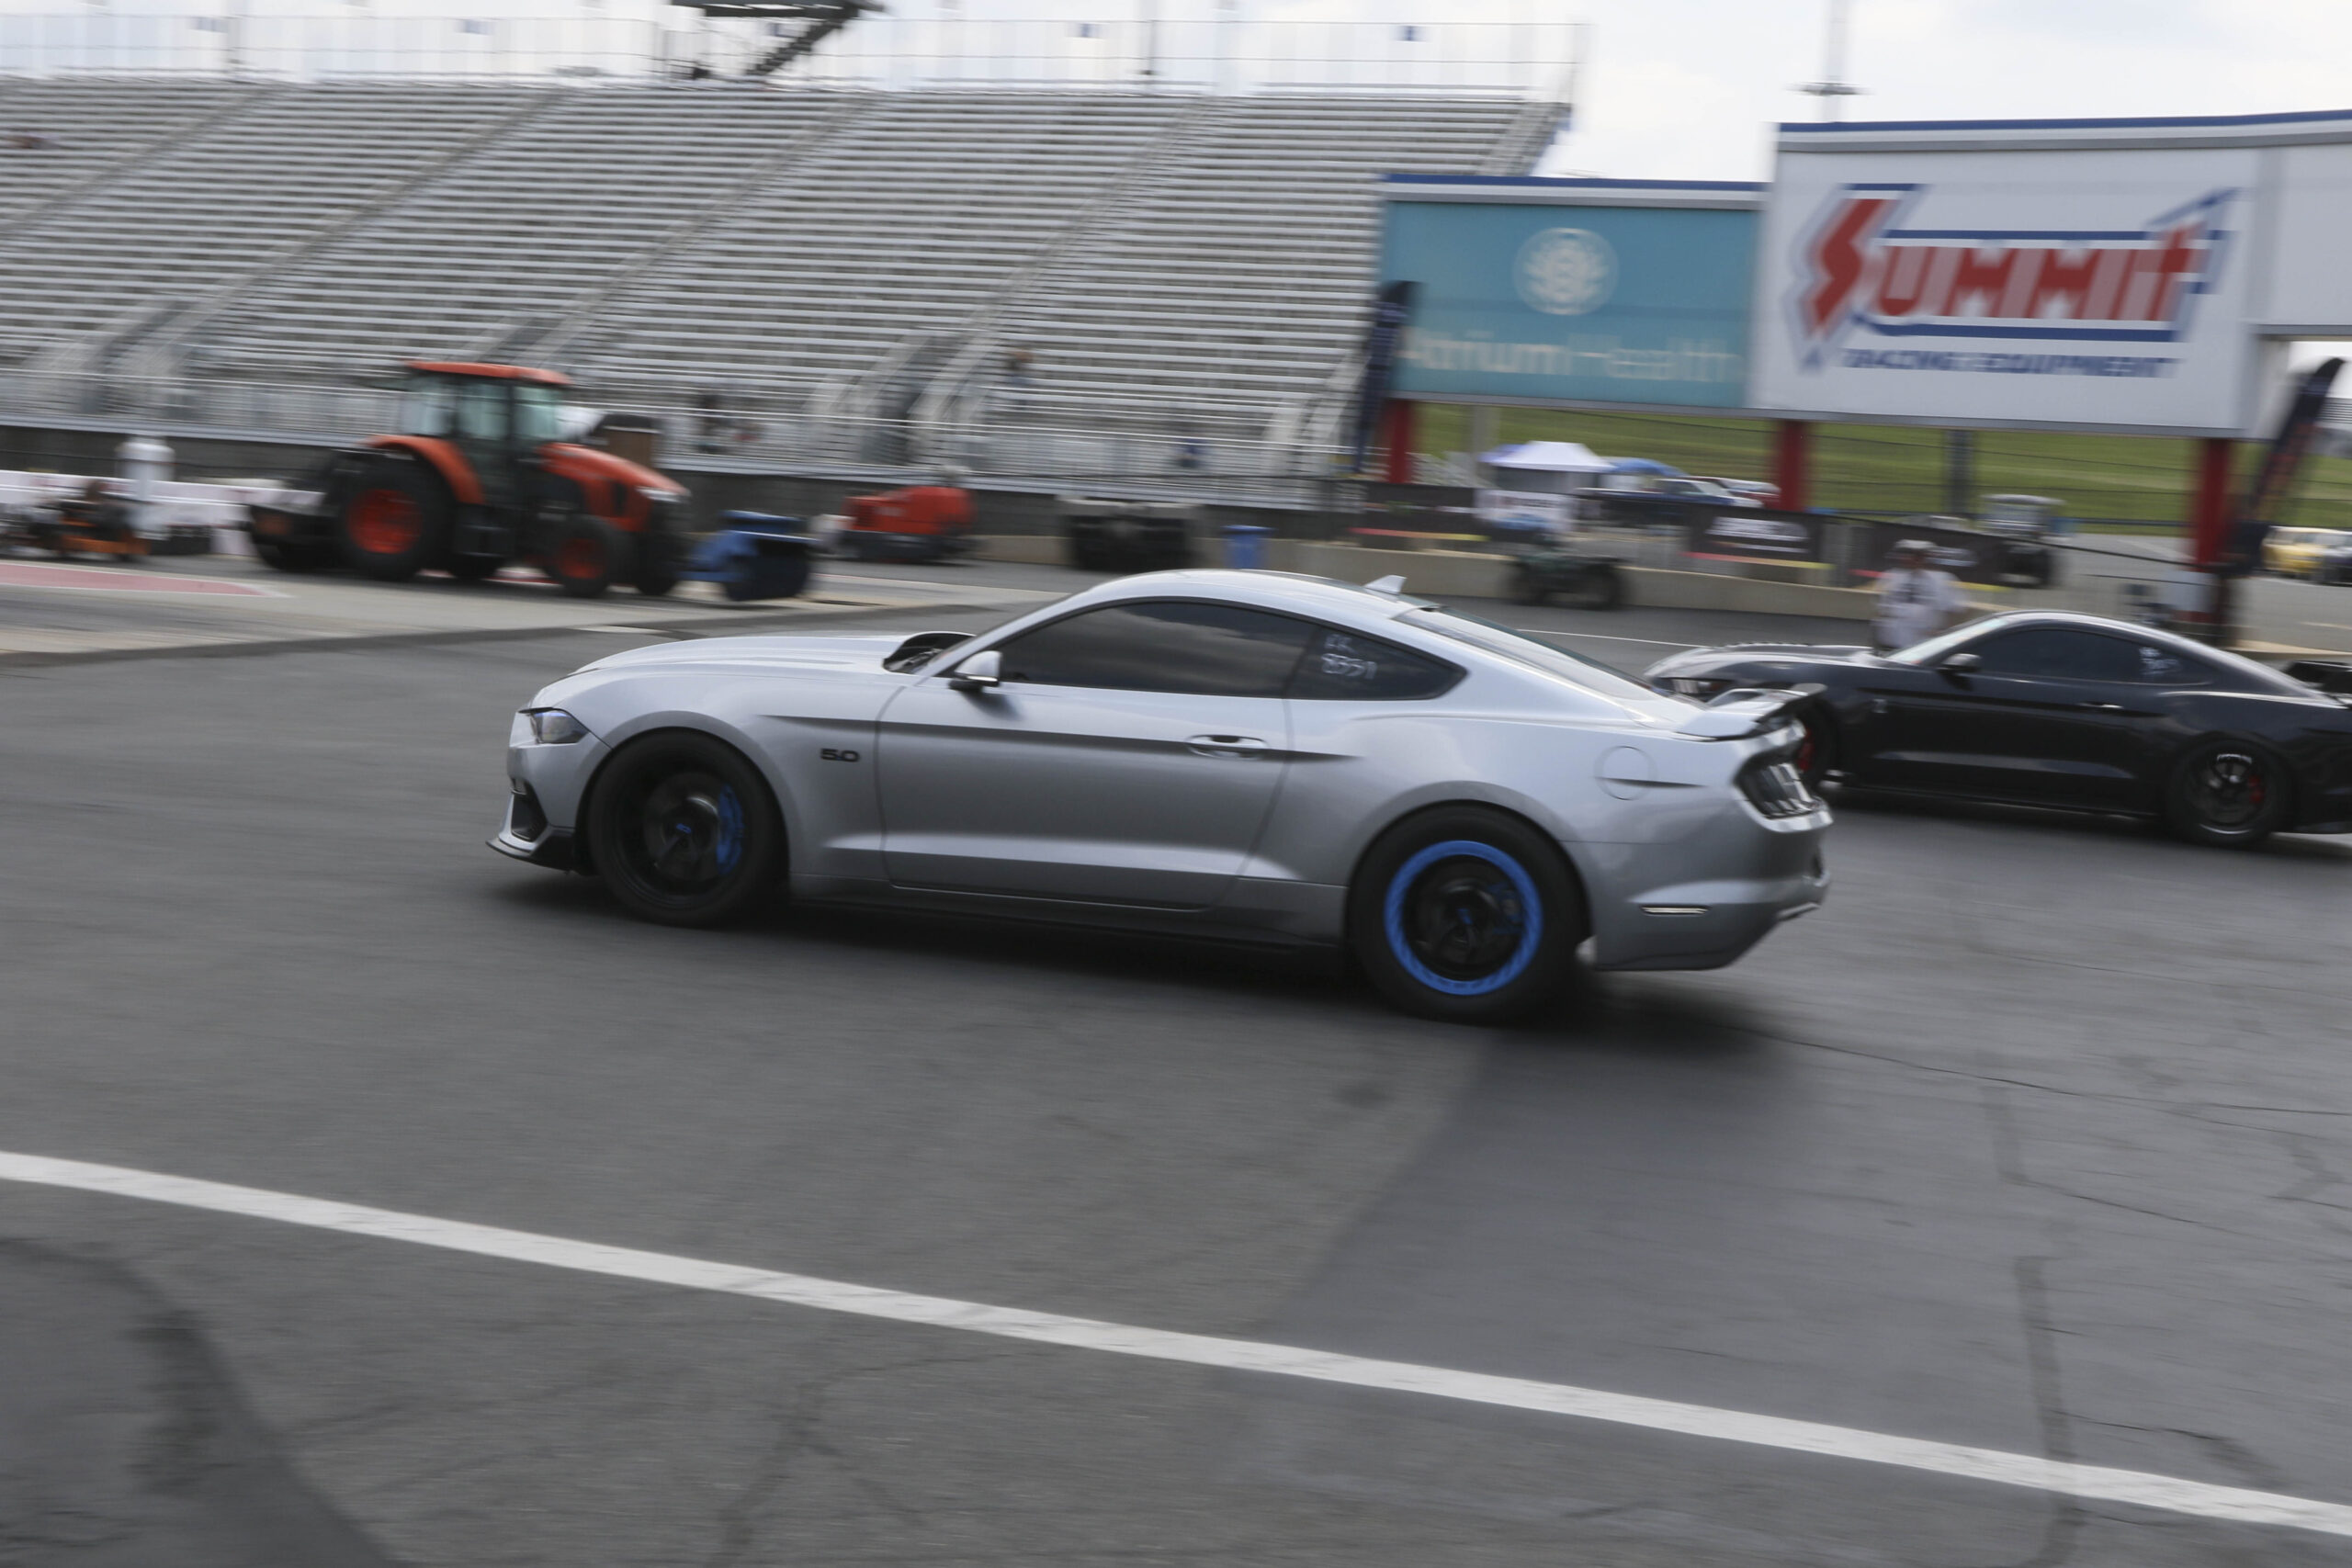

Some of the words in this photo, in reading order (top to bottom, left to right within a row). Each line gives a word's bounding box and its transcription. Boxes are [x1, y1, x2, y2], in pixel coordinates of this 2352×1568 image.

[1569, 333, 1742, 383] Health
[1841, 348, 1972, 372] RACING
[1975, 352, 2181, 378] EQUIPMENT
